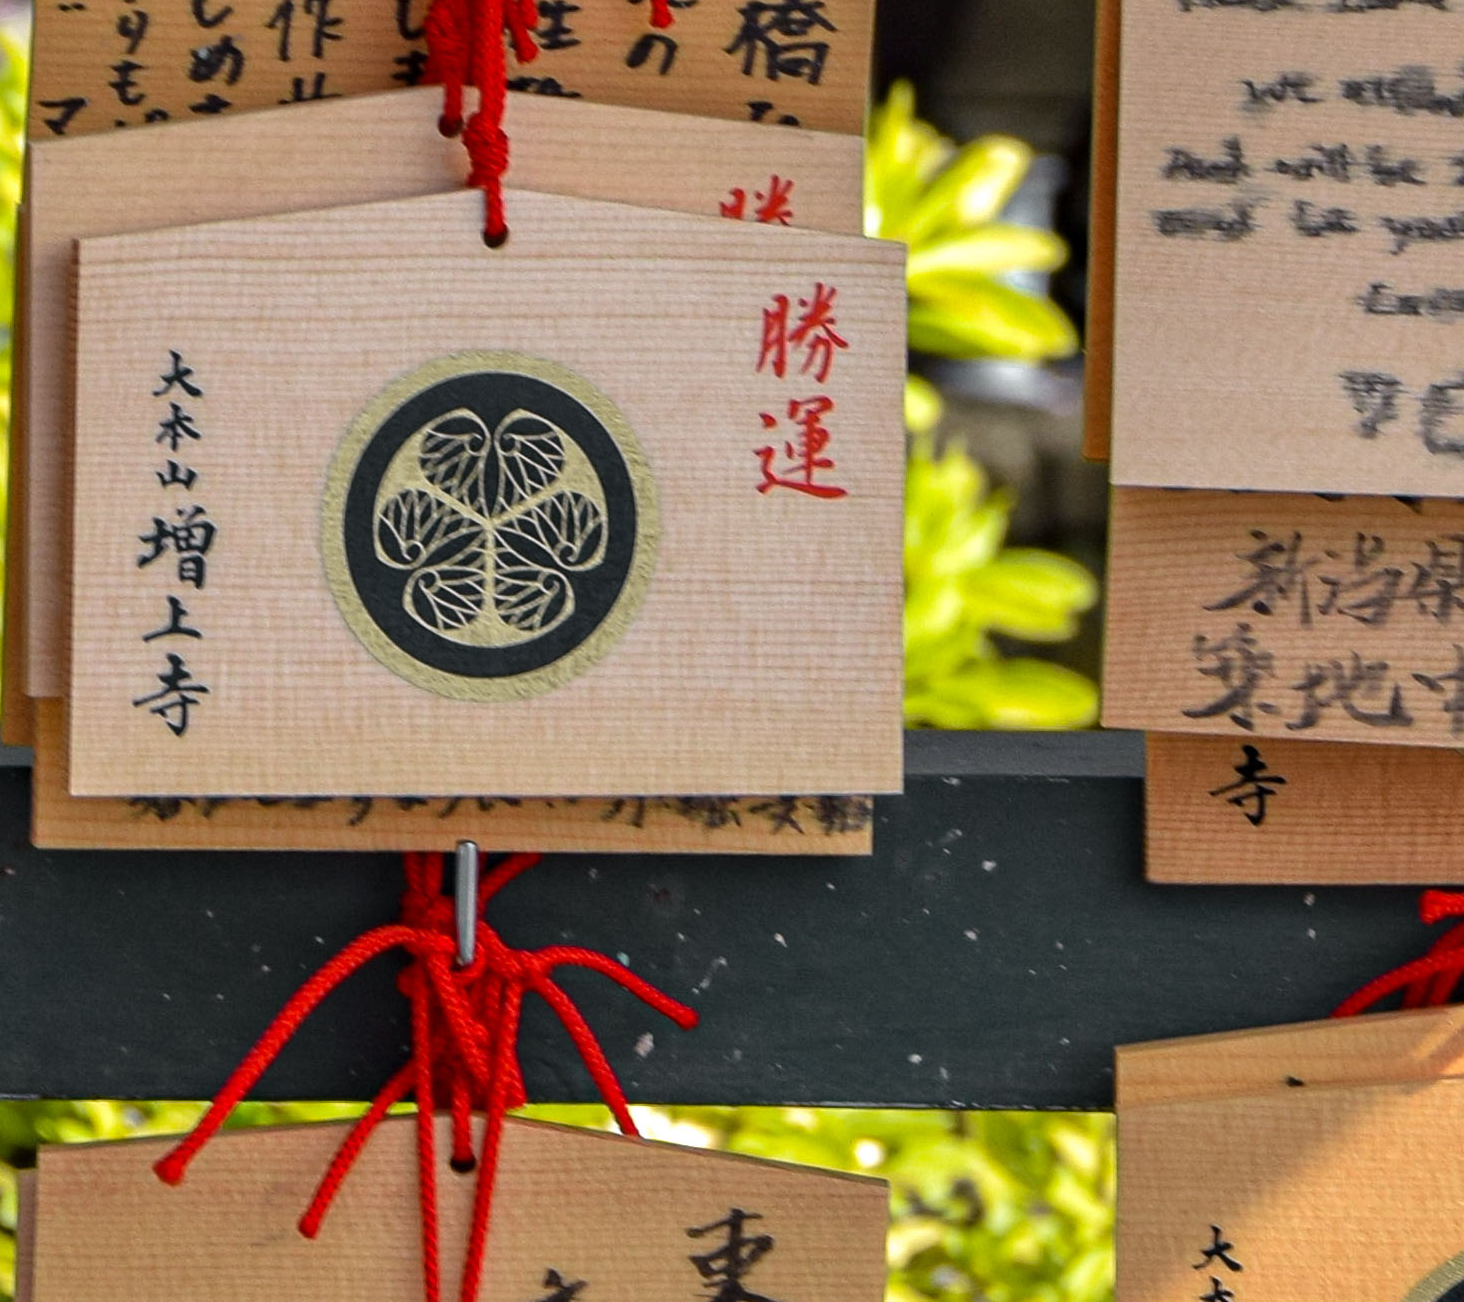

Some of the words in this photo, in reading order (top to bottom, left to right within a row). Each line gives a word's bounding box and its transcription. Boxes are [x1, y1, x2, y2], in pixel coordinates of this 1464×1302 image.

[754, 281, 850, 501] 勝運
[132, 351, 218, 736] 大本山増上寺
[1210, 744, 1287, 825] 寺
